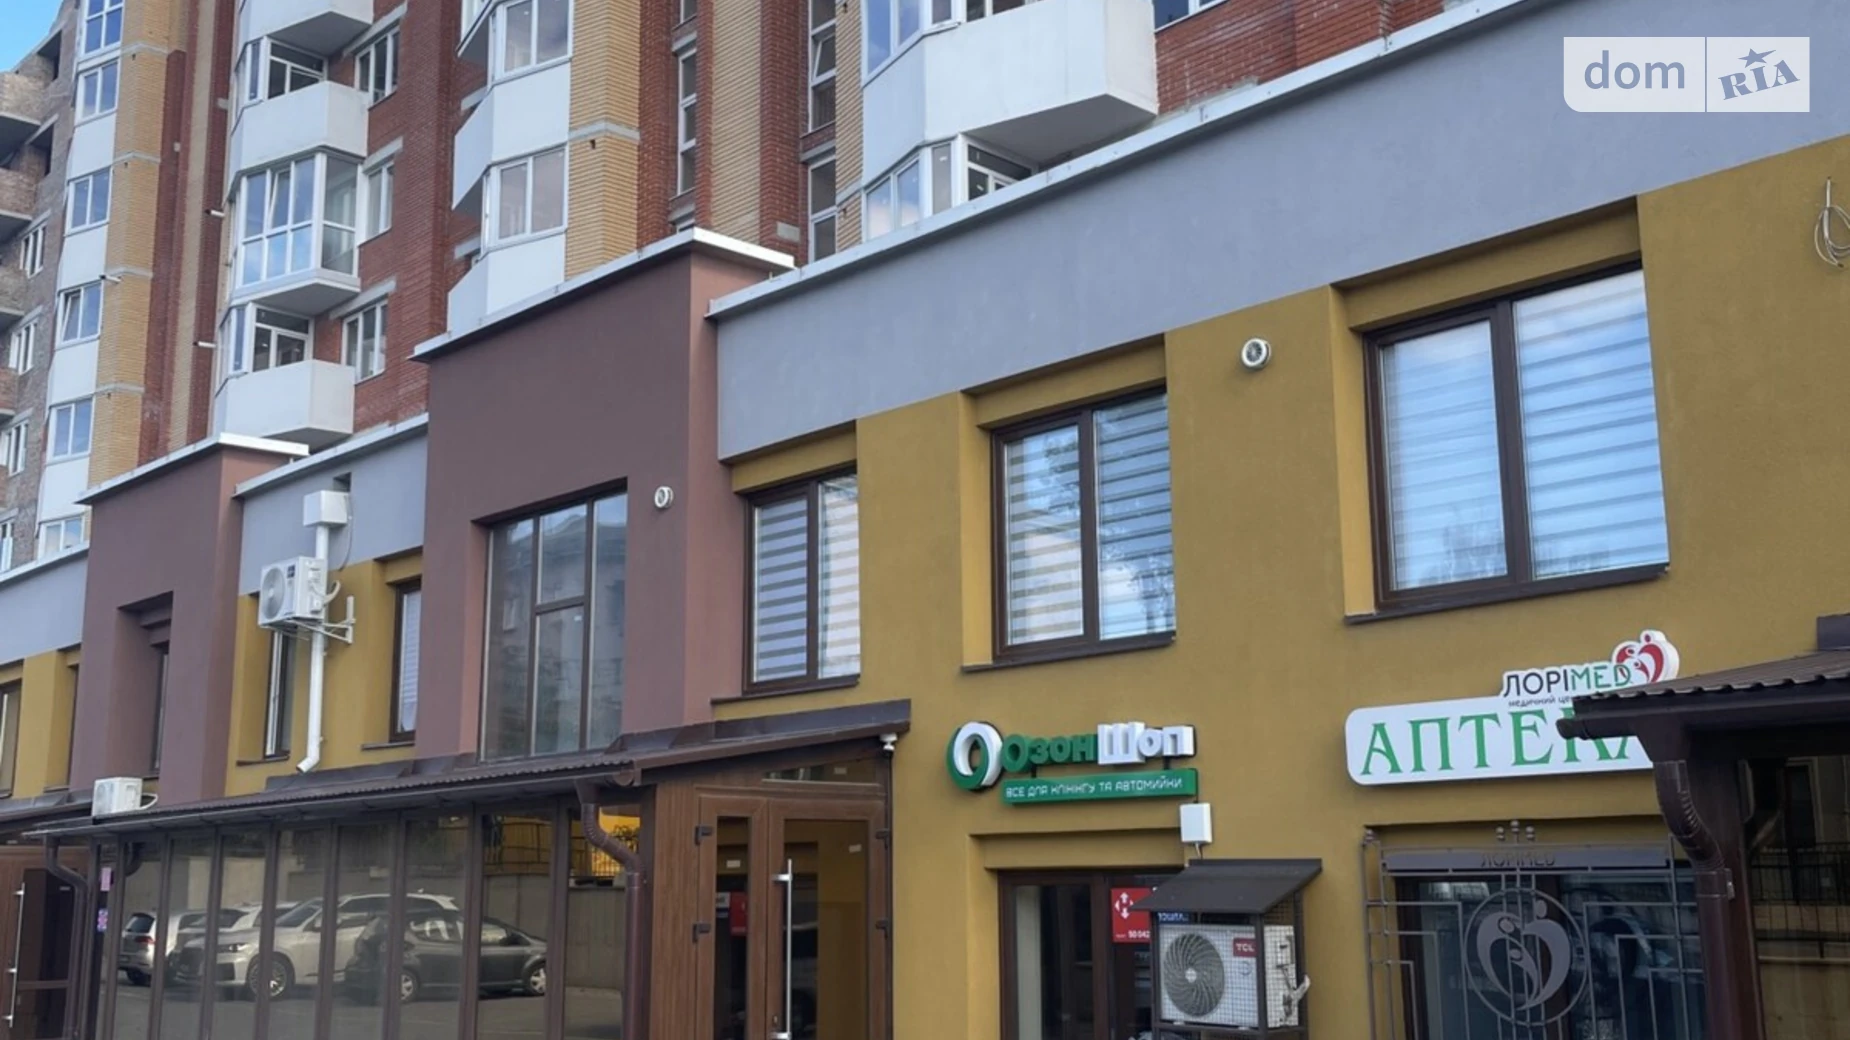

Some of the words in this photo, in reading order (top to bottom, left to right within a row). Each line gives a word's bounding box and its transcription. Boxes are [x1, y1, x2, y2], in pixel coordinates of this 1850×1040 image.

[1361, 708, 1629, 775] АПТЕК
[1006, 787, 1025, 798] ВСЕ
[1027, 786, 1048, 797] ДЛЯ
[1099, 782, 1112, 792] ТА
[1115, 776, 1183, 791] АВТОМИЙКИ
[1235, 943, 1255, 952] TCL
